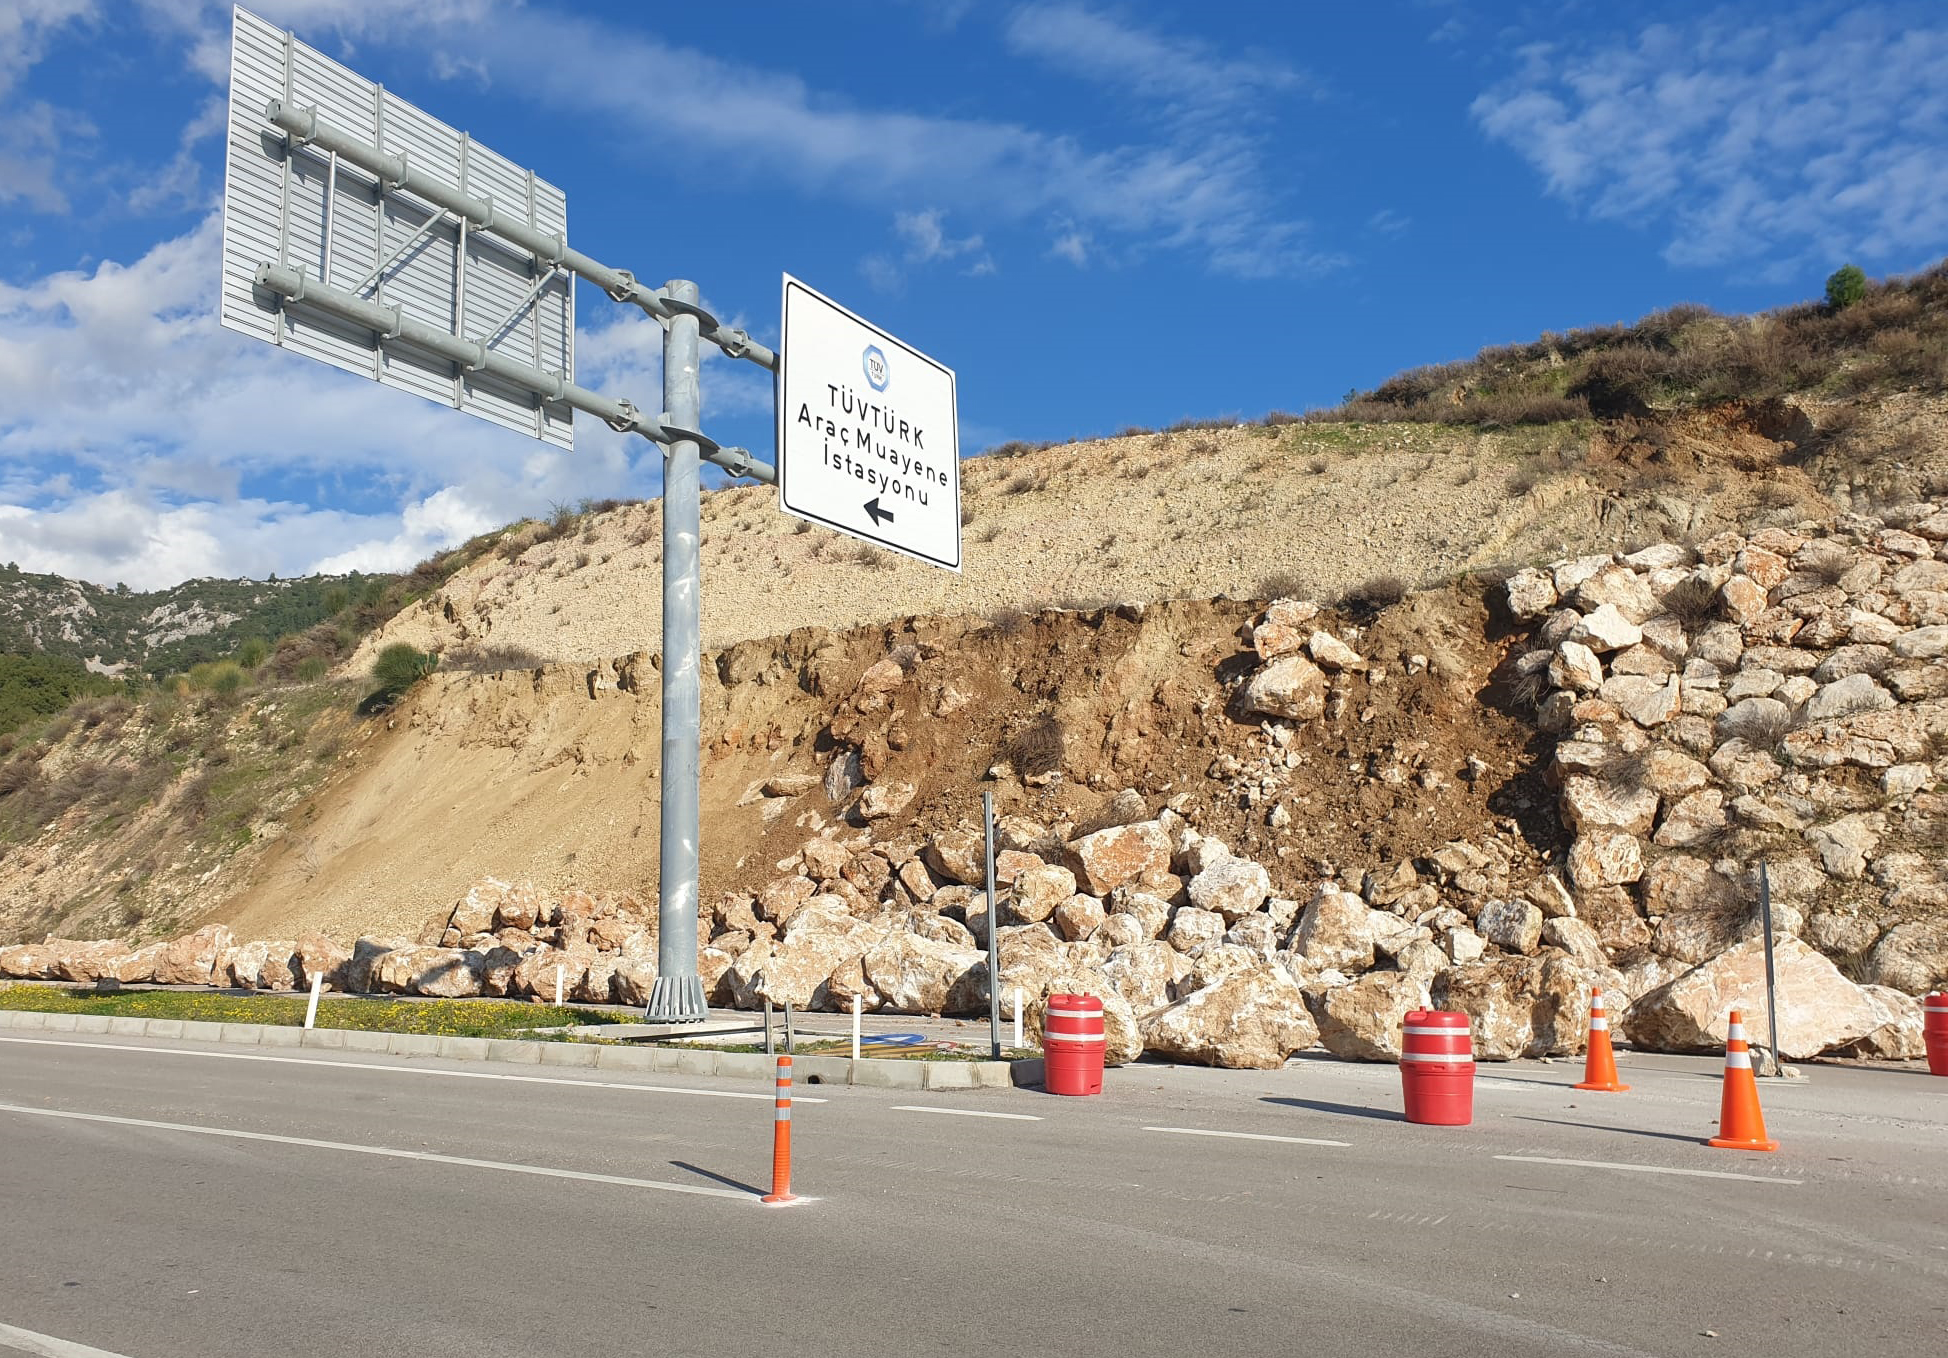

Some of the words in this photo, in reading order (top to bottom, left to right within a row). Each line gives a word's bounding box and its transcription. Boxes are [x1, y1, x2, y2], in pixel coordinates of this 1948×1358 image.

[798, 403, 849, 447] Araç
[857, 427, 948, 487] Muayene
[827, 384, 924, 450] TÜVTÜRK
[824, 437, 928, 506] İstasyonu
